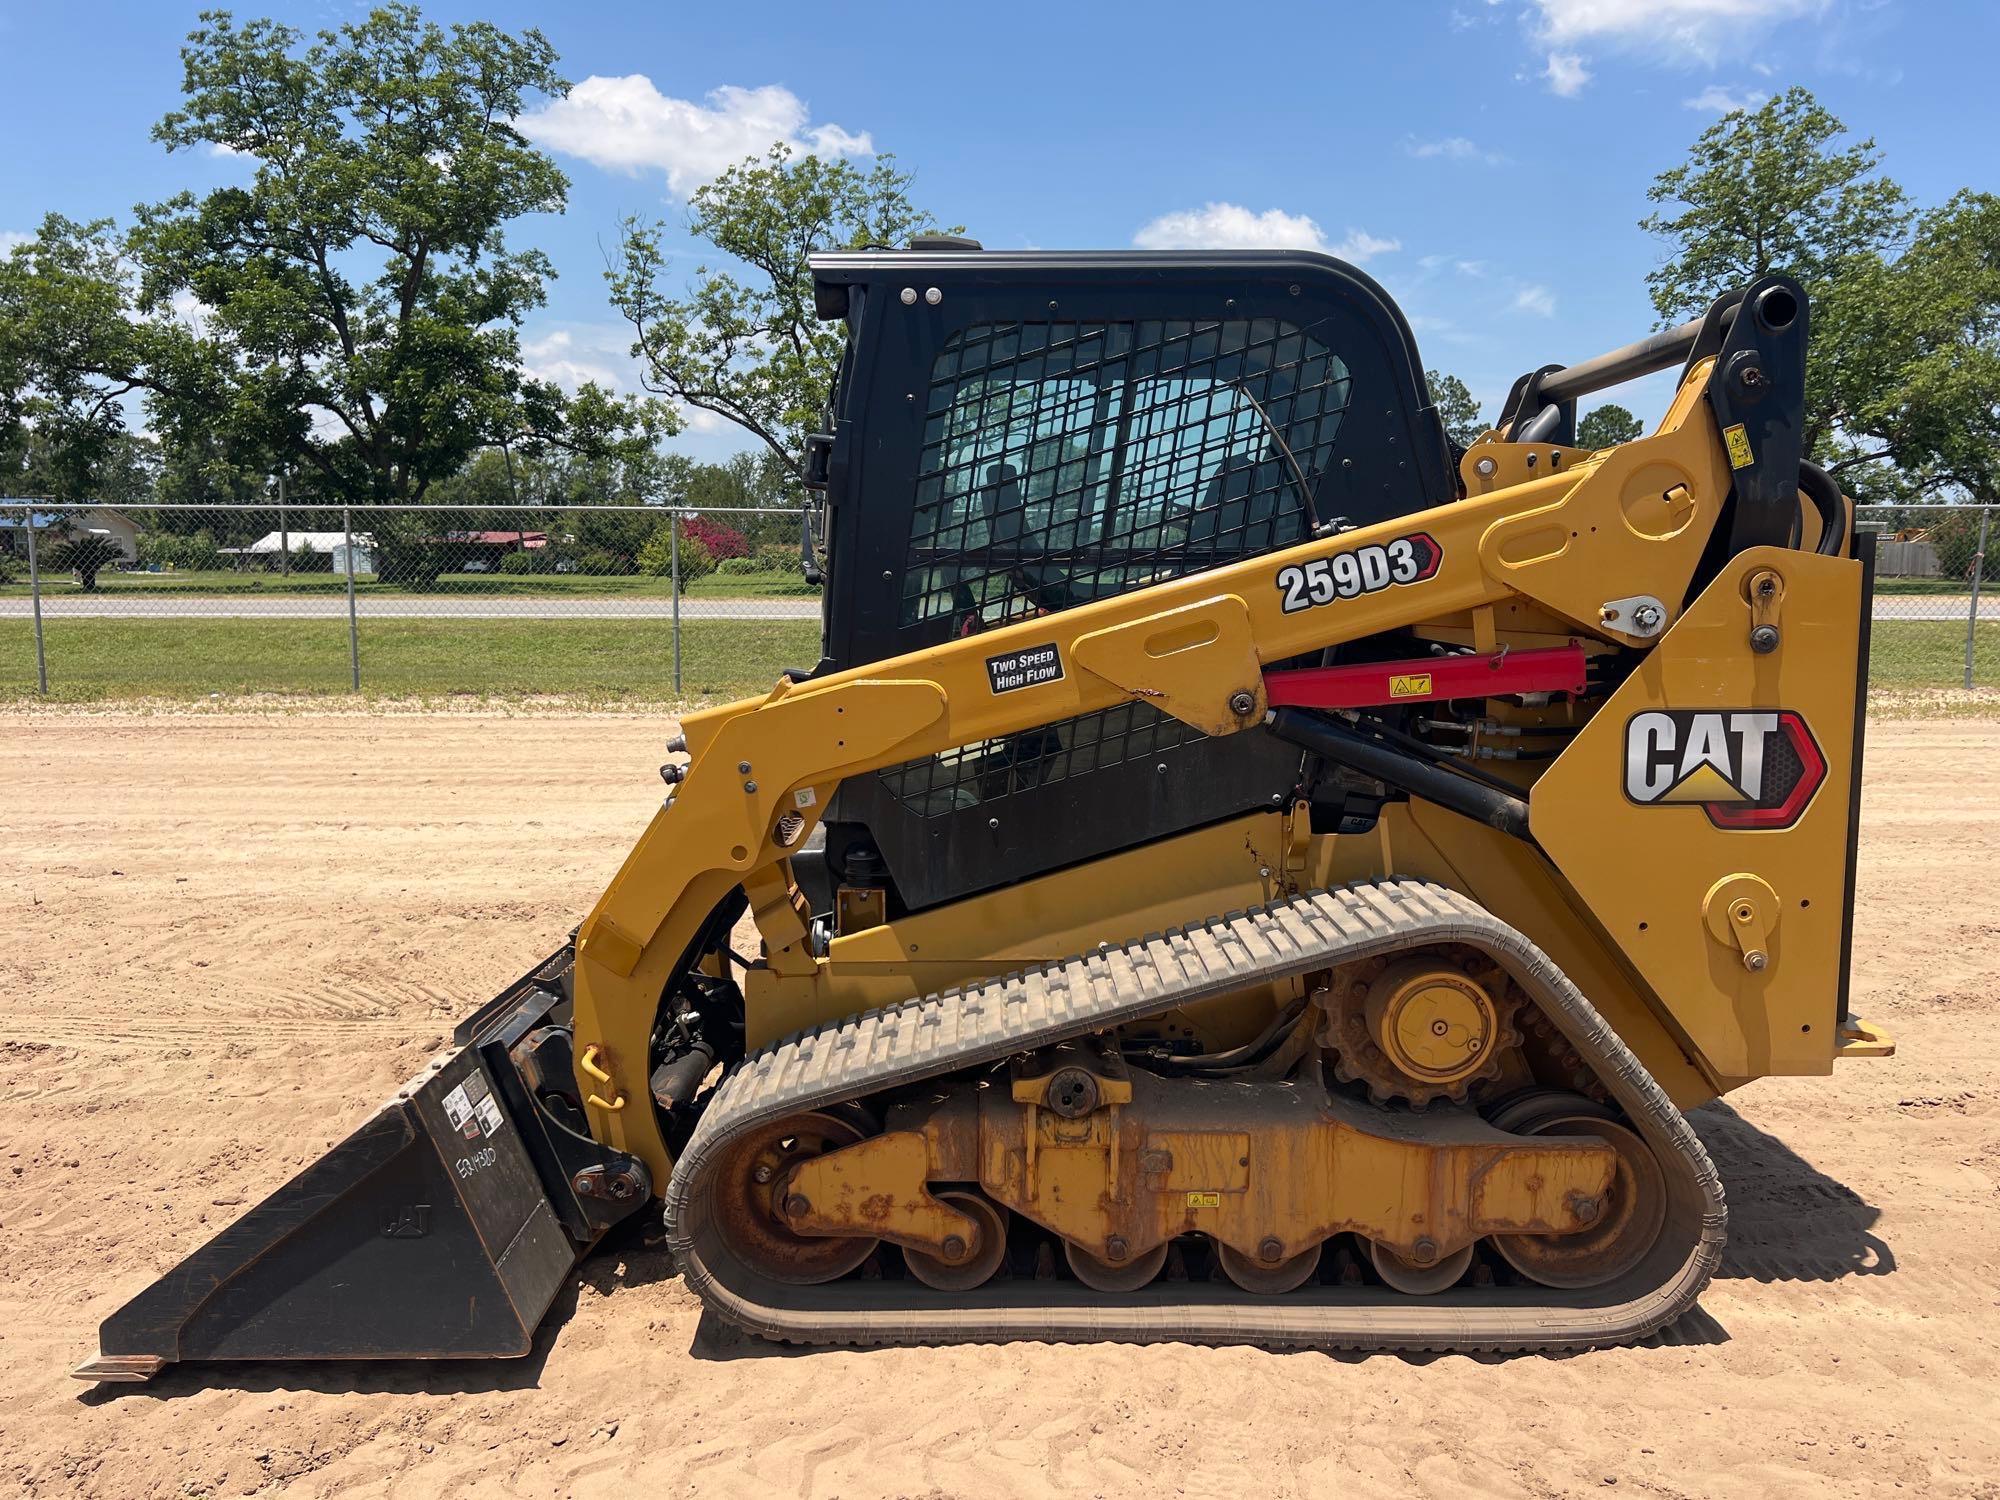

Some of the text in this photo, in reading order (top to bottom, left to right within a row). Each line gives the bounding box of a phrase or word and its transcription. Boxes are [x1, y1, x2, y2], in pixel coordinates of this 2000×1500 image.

[1278, 539, 1418, 611] 259D3
[991, 650, 1054, 675] TWO SPEED
[996, 666, 1056, 690] HIGH FLOW
[1627, 712, 1779, 802] CAT
[455, 1147, 497, 1179] EQ14380
